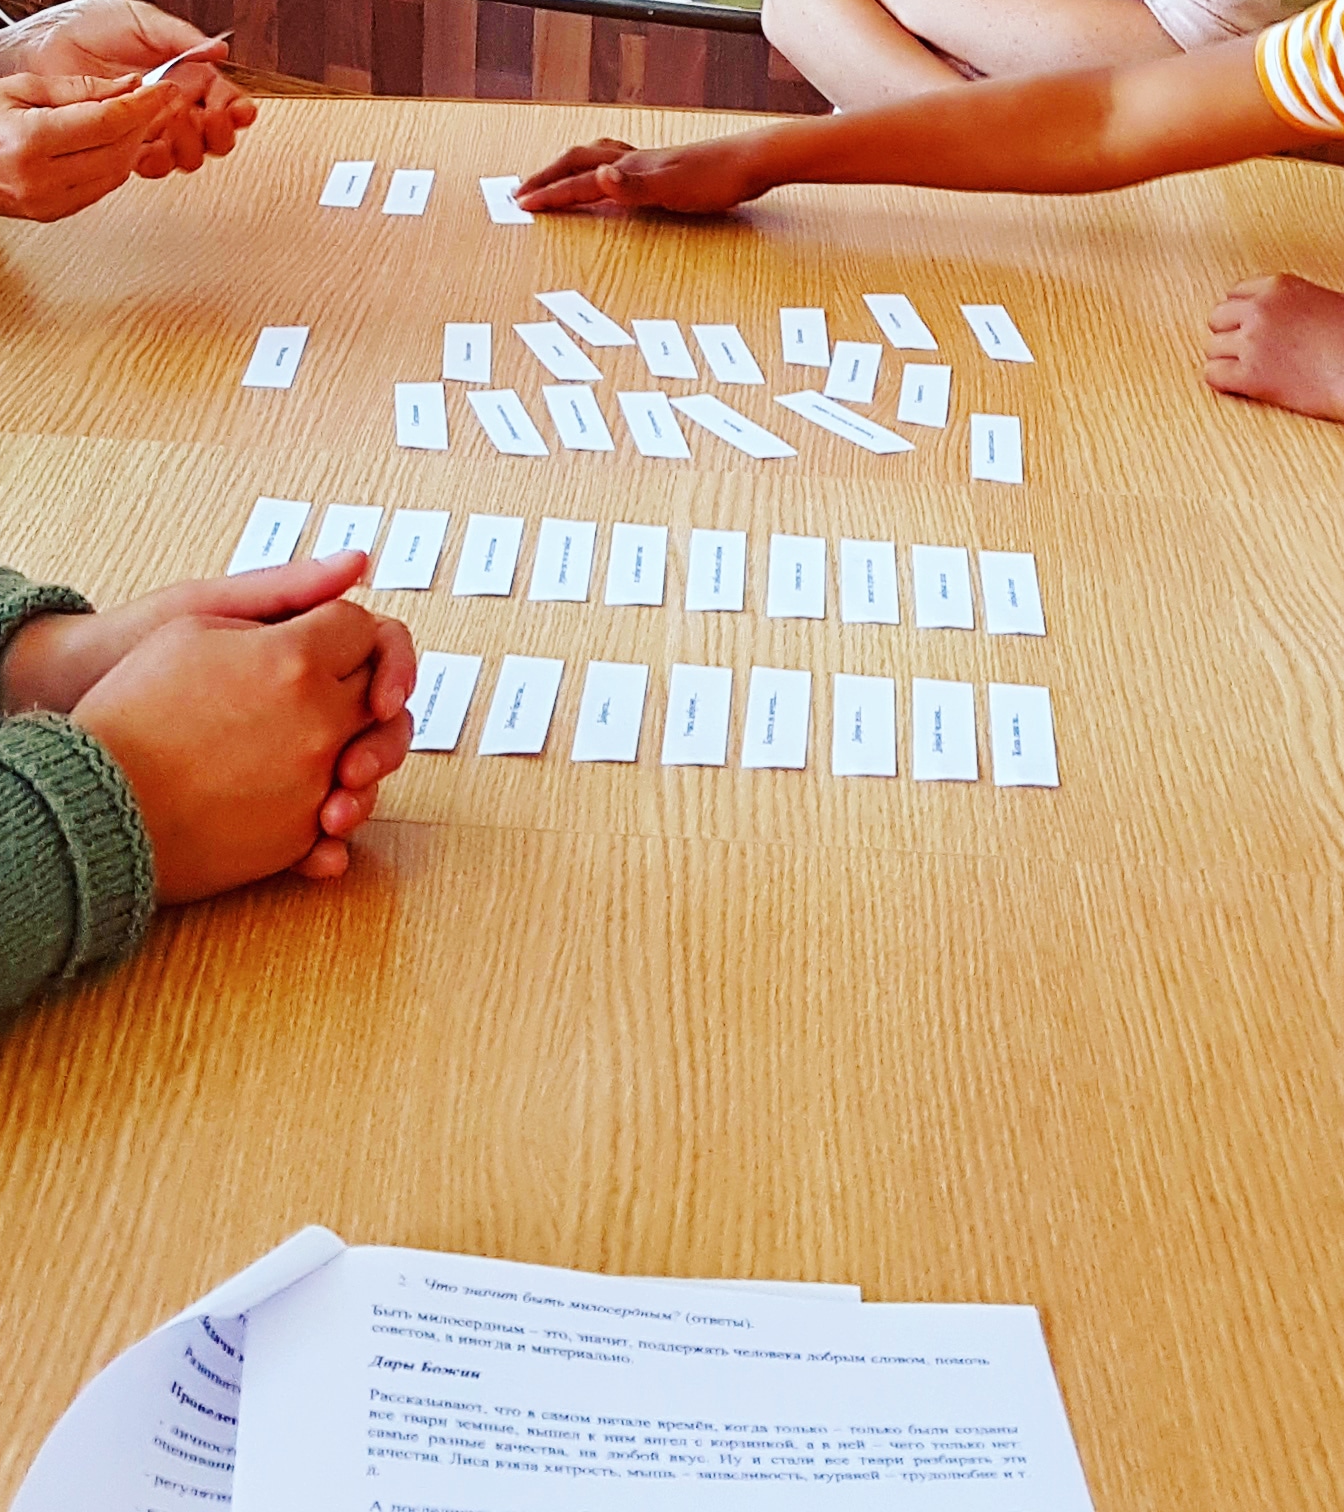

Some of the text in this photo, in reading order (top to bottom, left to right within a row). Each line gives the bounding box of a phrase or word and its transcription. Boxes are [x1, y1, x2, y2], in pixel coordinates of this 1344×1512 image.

[424, 1277, 458, 1294] Что
[523, 1292, 565, 1308] быть
[371, 1303, 413, 1321] Быть
[368, 1354, 415, 1372] Дары
[494, 1406, 522, 1418] что
